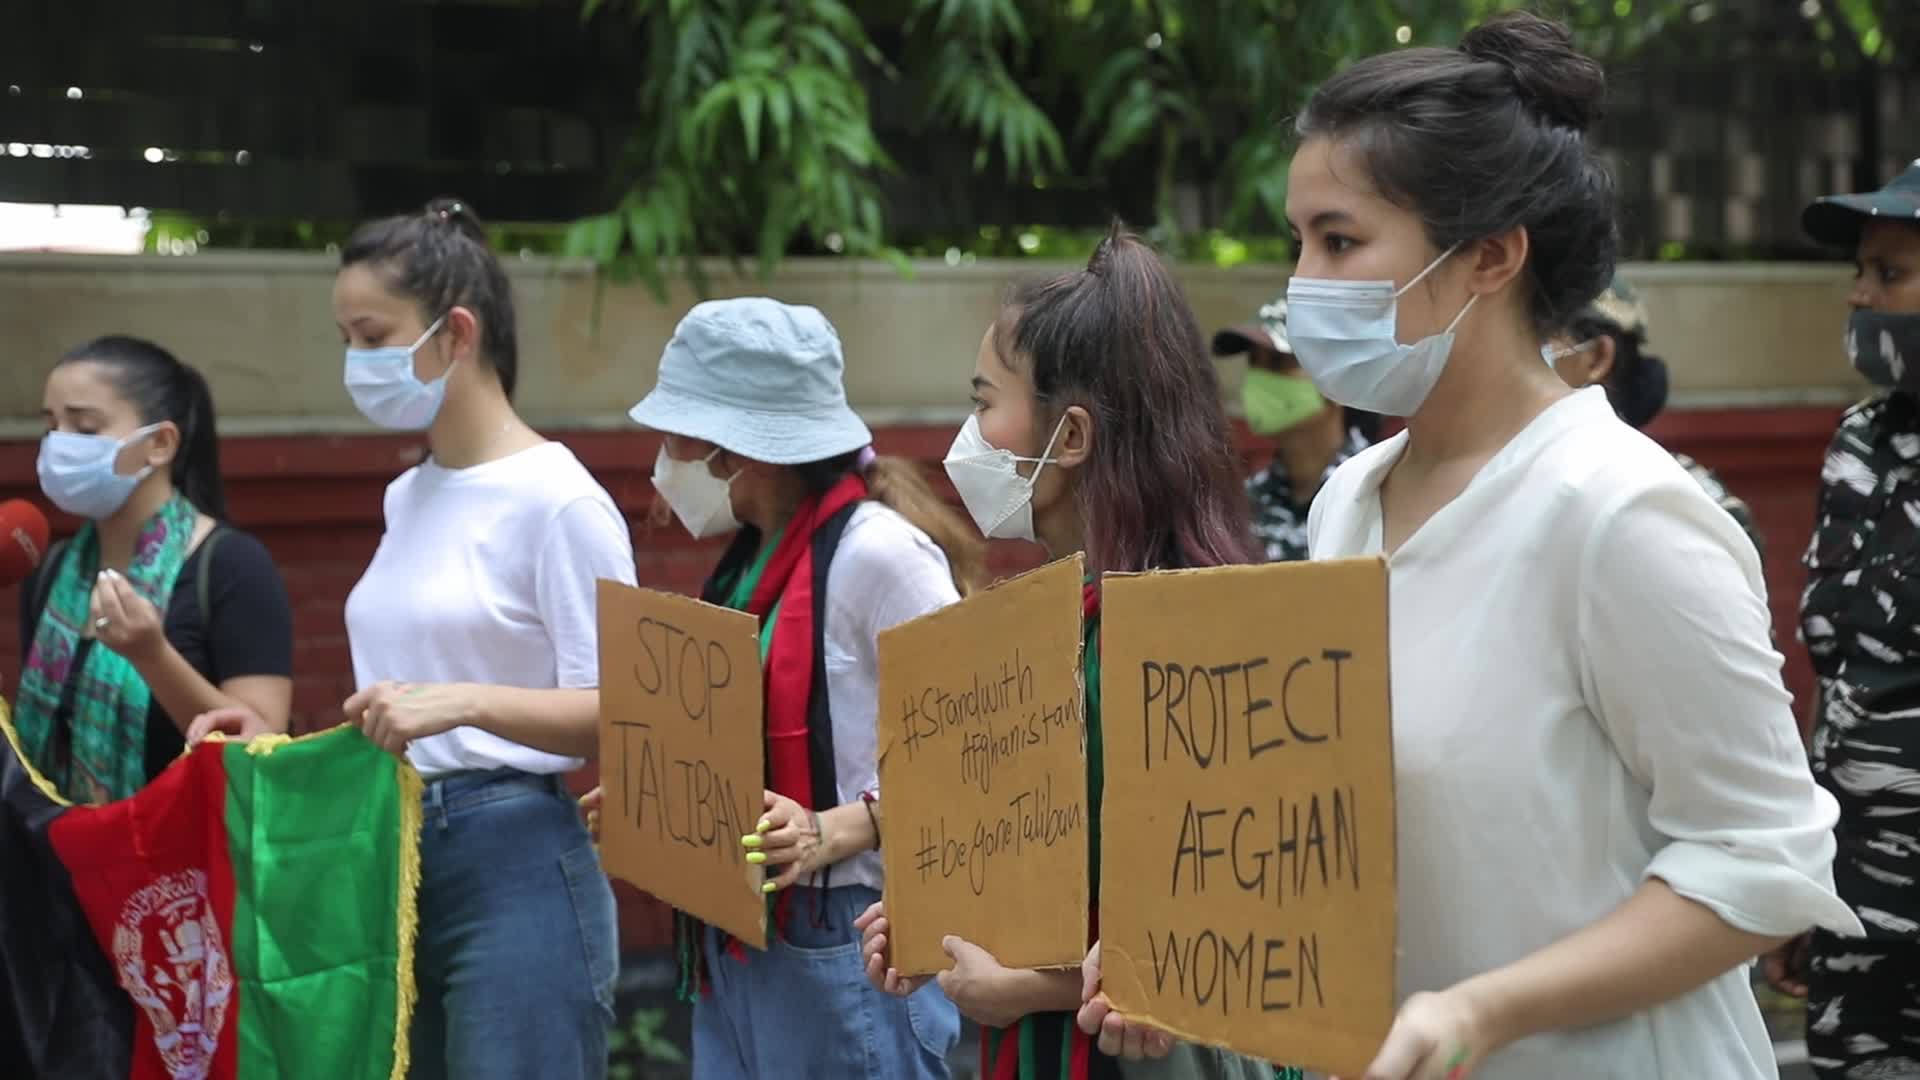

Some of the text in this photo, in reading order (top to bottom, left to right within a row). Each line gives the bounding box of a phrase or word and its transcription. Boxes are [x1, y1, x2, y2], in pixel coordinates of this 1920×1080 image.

[634, 617, 731, 737] STOP
[1143, 649, 1352, 772] PROTECT
[611, 720, 750, 866] TALIBAN
[961, 697, 1079, 794] Afghanistan
[1171, 786, 1360, 907] AFGHAN
[1148, 929, 1323, 1015] WOMEN
